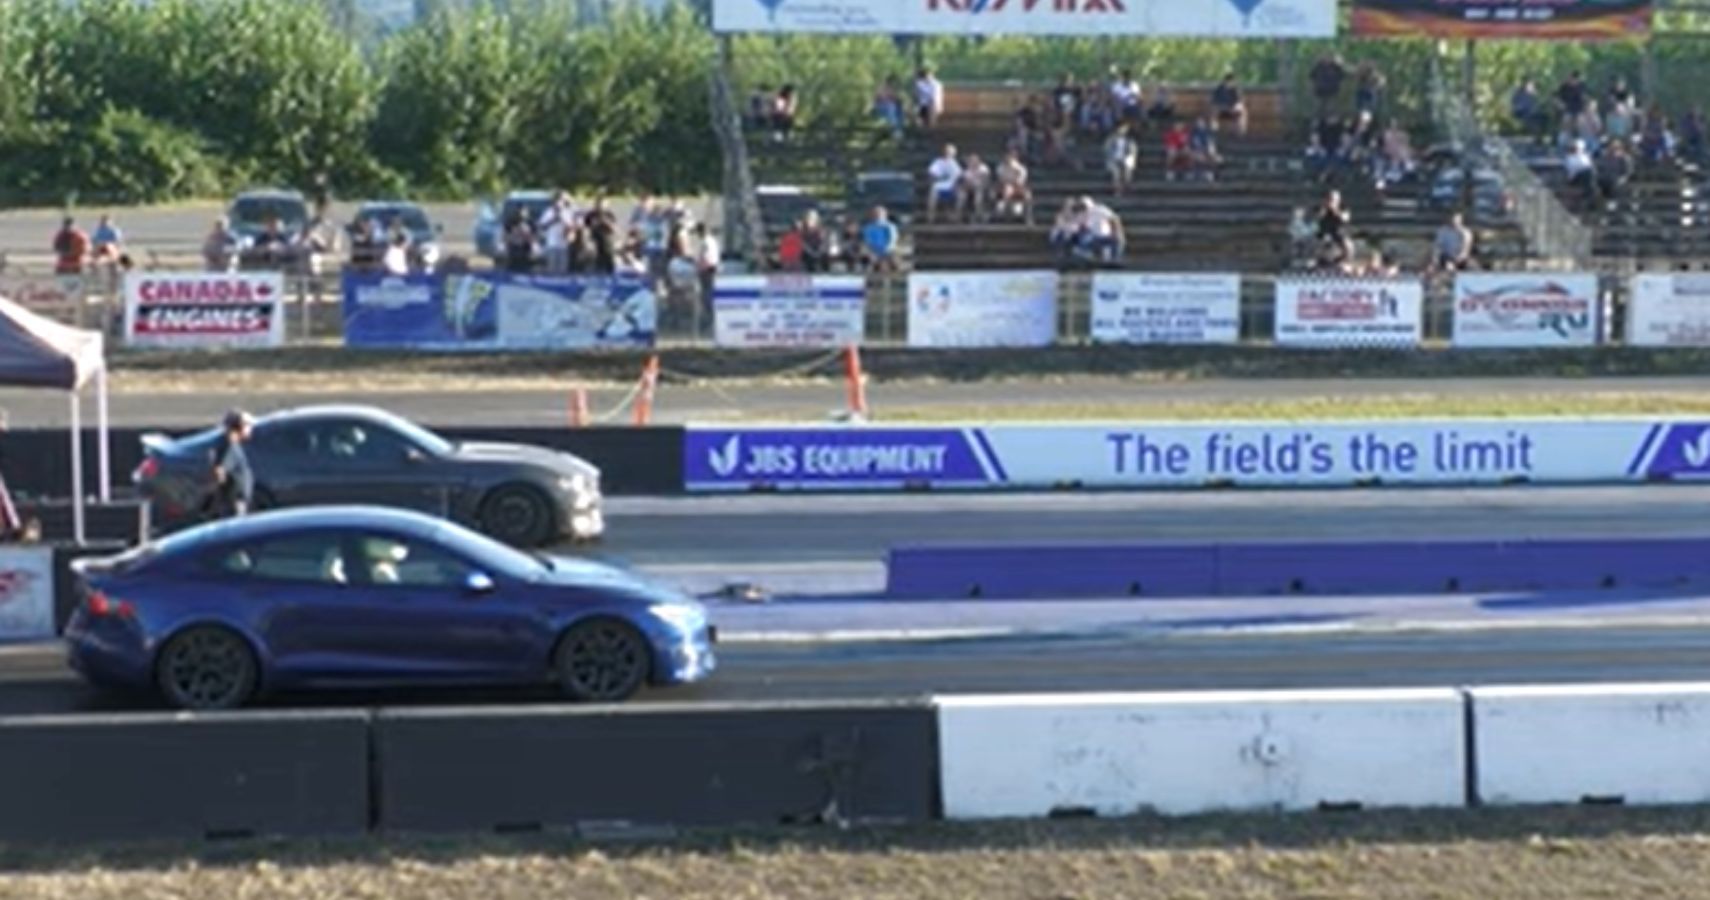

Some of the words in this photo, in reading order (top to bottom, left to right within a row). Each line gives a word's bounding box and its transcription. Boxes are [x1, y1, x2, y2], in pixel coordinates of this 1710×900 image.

[139, 281, 251, 300] CANADA
[148, 304, 262, 328] ENGINES
[745, 443, 797, 474] JBS
[803, 443, 947, 474] EQUIPMENT
[1107, 433, 1190, 473] The
[1205, 431, 1333, 474] field's
[1349, 432, 1418, 472] the
[1434, 431, 1533, 472] limit
